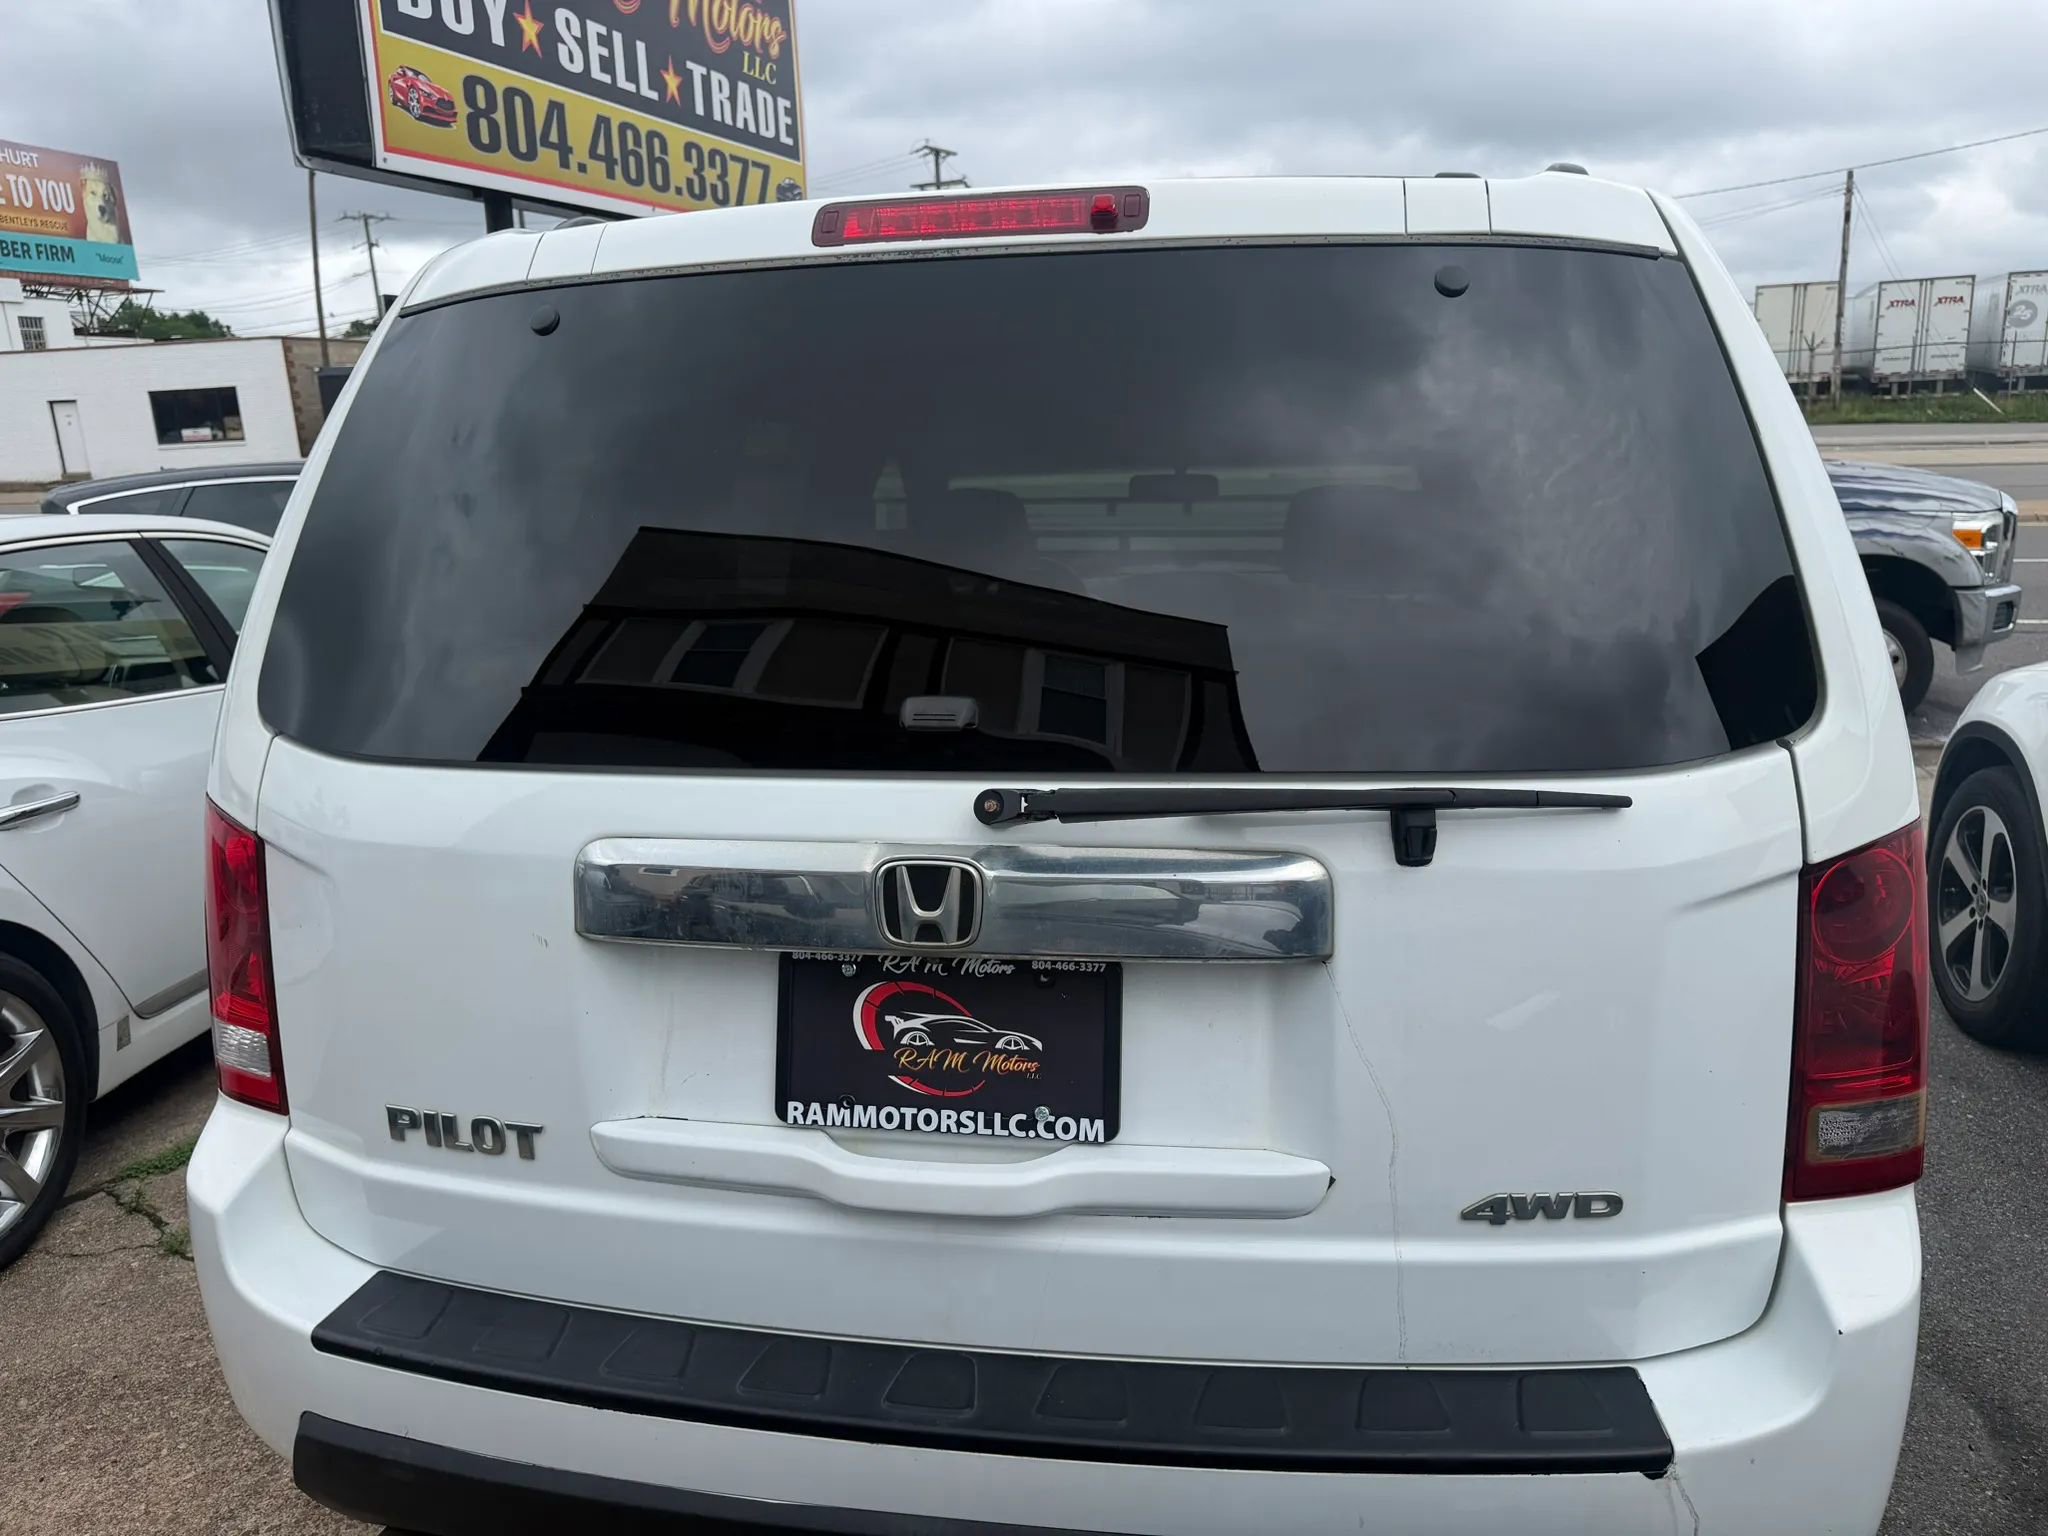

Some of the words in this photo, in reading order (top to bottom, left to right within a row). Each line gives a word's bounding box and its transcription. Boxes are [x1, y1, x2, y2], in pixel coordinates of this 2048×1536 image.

[398, 0, 507, 47] UY
[554, 7, 660, 101] SELL
[685, 60, 794, 146] TRADE
[742, 51, 777, 84] LLC
[463, 75, 771, 206] 804.466.3377
[6, 174, 33, 208] TO
[34, 178, 75, 213] YOU
[0, 239, 32, 259] BER
[35, 243, 75, 263] FIRM
[1032, 960, 1107, 973] 804-466-3377
[893, 1047, 970, 1073] RAM
[972, 1050, 1041, 1075] Motors
[385, 1104, 544, 1161] PILOT
[786, 1100, 1106, 1144] RAMMOTORSLLC.COM
[1461, 1191, 1624, 1226] 4WD
